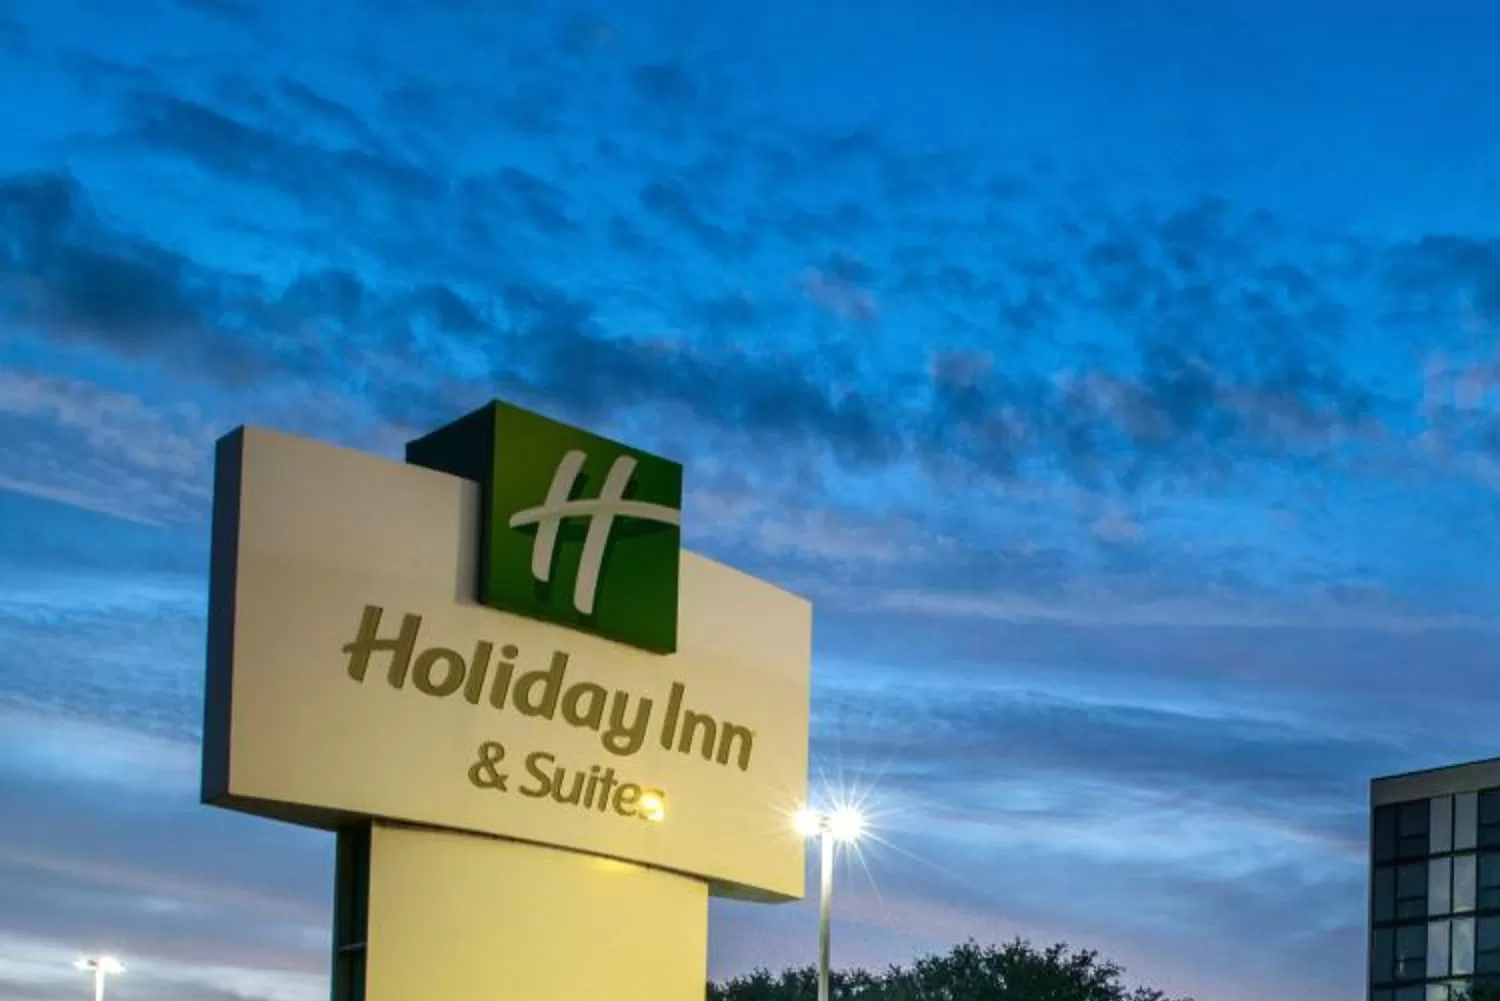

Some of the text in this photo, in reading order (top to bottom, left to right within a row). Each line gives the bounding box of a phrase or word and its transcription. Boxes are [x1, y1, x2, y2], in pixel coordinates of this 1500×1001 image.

[342, 604, 755, 771] Holiday Inn
[467, 740, 509, 793] &
